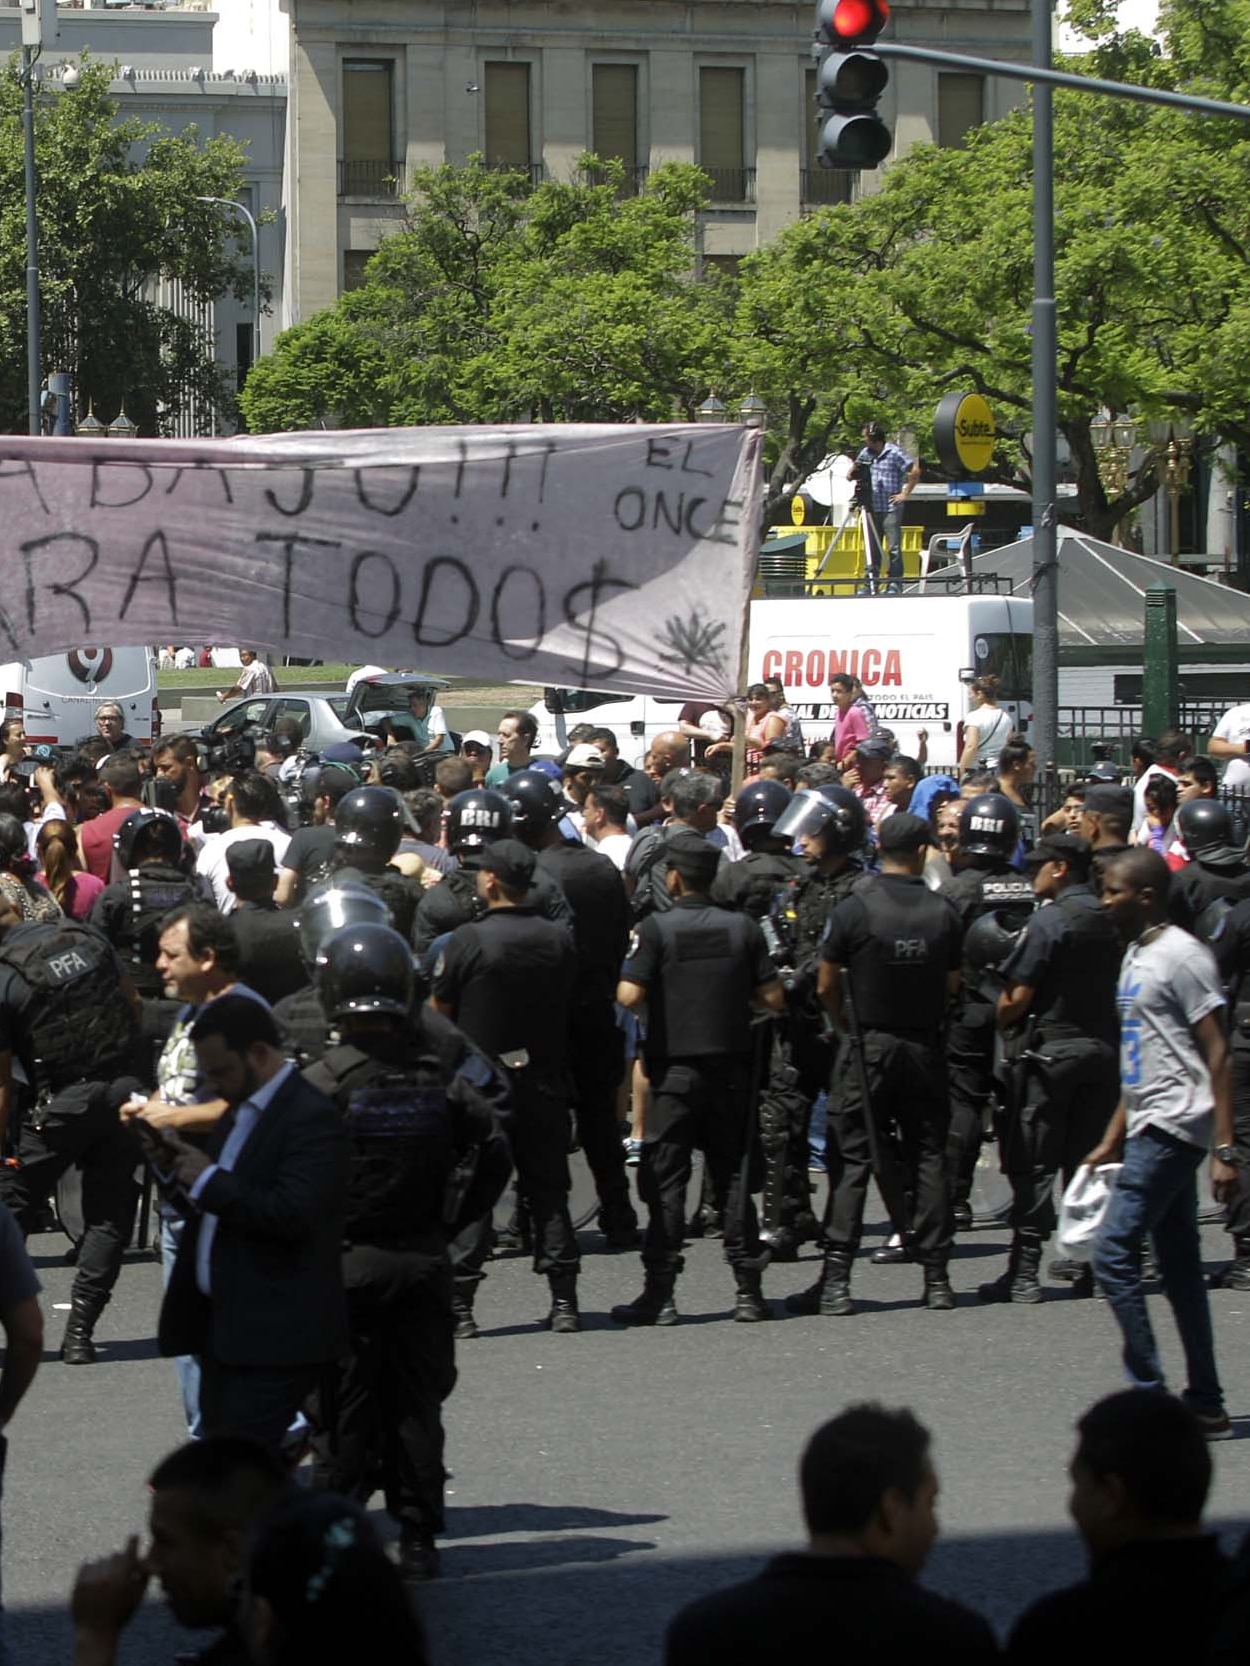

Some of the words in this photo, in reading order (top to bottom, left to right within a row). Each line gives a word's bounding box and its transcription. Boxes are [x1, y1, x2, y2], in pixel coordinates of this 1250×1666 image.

[644, 435, 695, 479] EL
[613, 484, 747, 547] ONCE
[762, 648, 903, 688] CRONICA
[875, 703, 947, 719] NOTICIAS
[460, 808, 500, 828] BRI
[969, 815, 1004, 834] BRI
[894, 938, 928, 959] PFA
[49, 951, 88, 979] PFA
